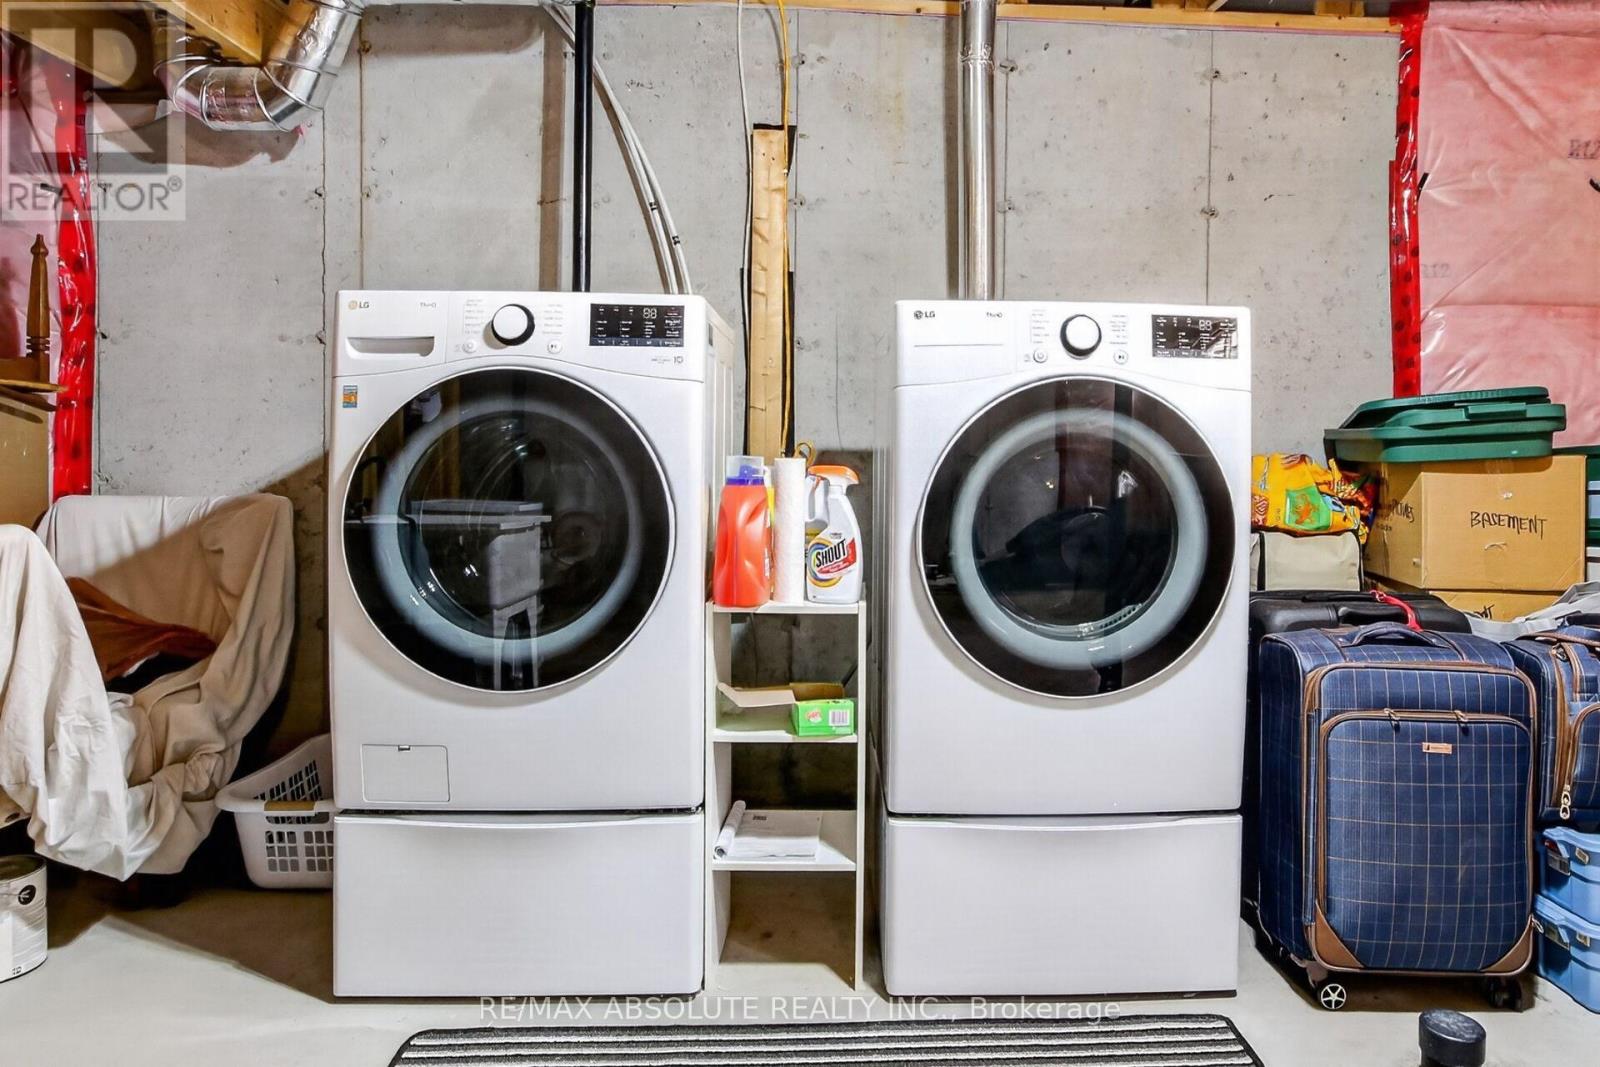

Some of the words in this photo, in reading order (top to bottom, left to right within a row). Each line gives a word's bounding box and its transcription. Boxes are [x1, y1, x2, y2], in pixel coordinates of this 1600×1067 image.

[359, 301, 370, 309] LG
[925, 311, 936, 319] LG
[1470, 511, 1548, 540] BASEMENT
[815, 538, 846, 568] SHOUT
